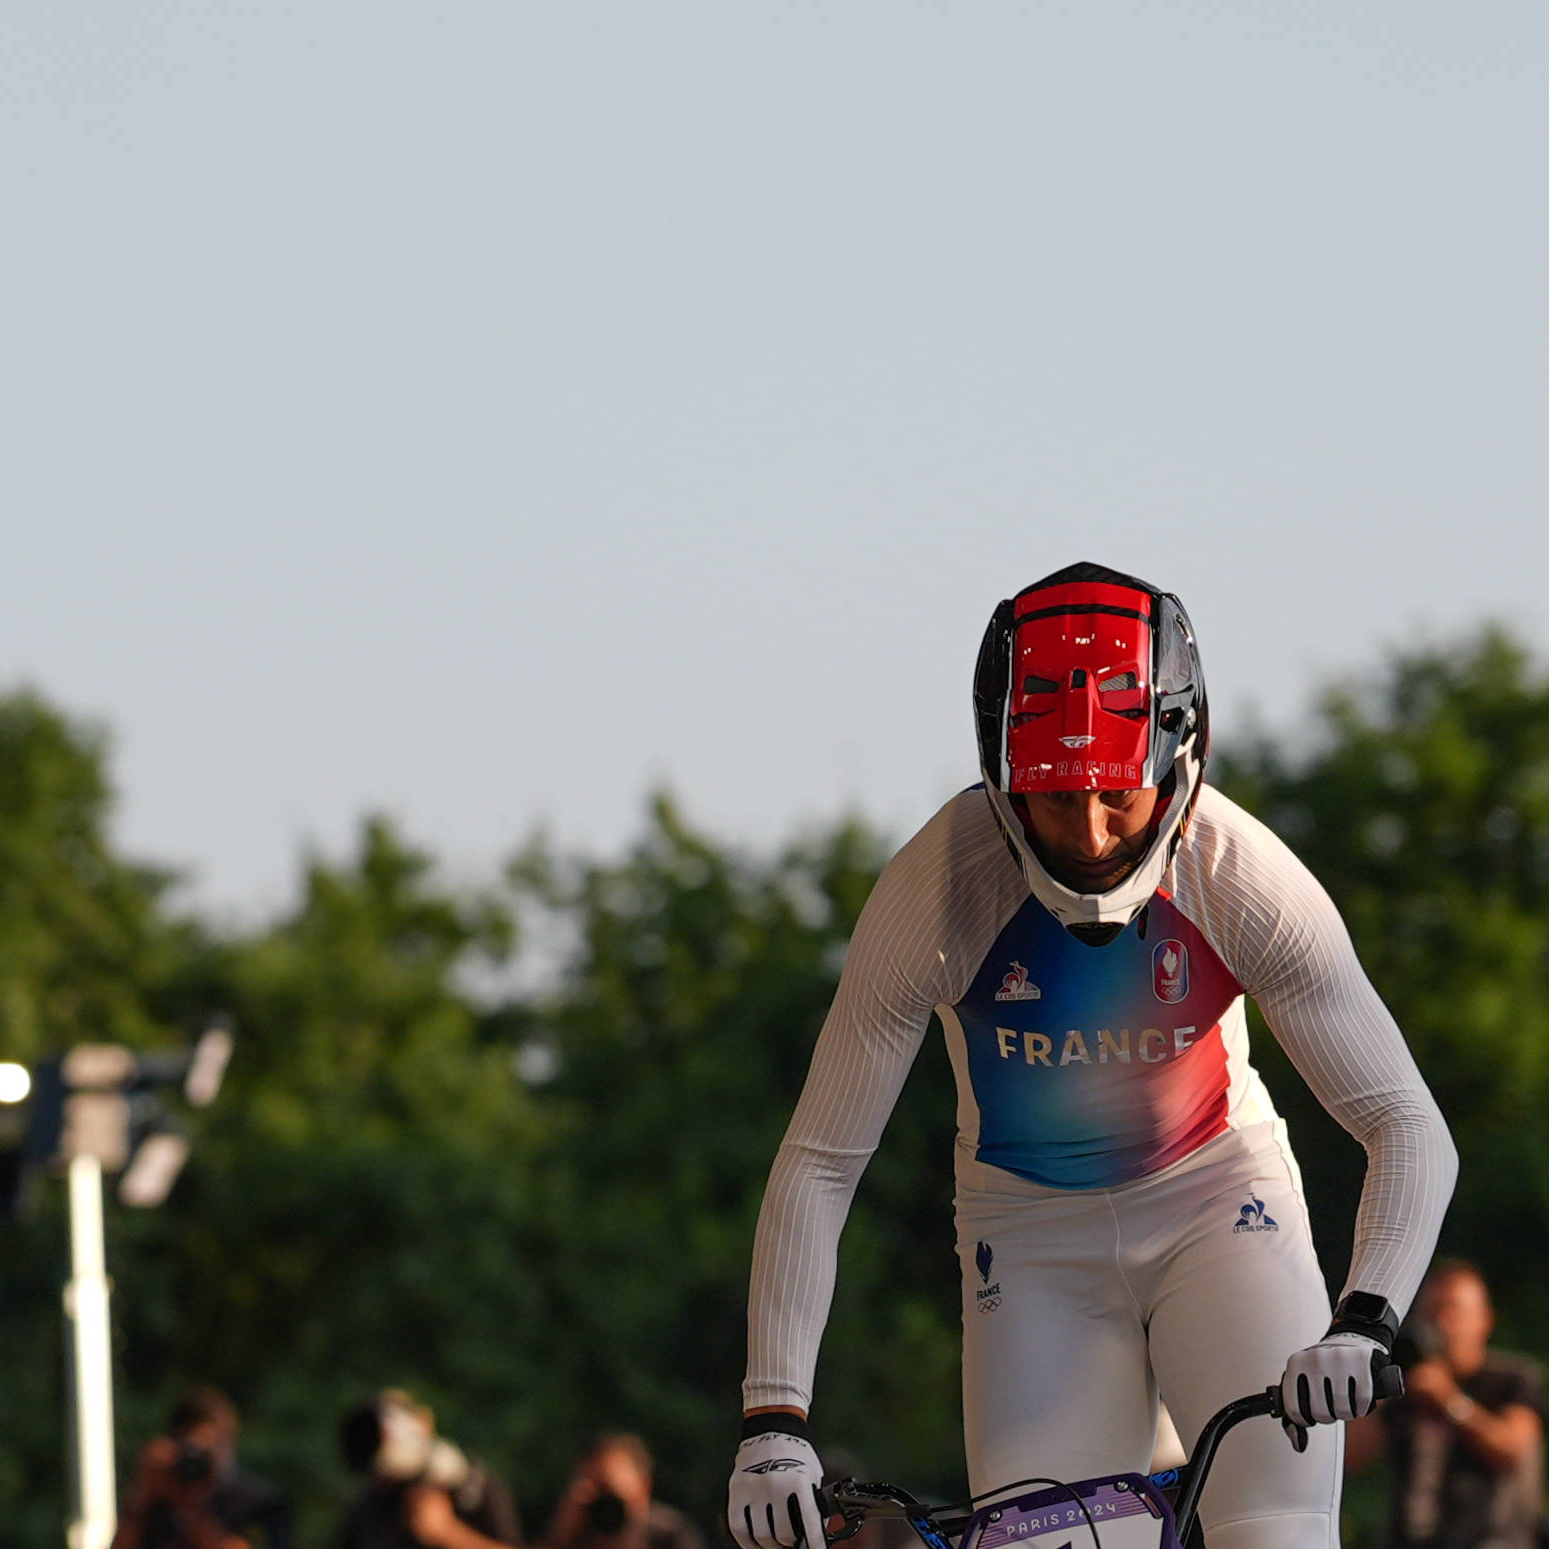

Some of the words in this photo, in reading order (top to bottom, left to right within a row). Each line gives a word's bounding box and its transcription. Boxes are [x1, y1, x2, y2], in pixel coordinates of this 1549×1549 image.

[1014, 763, 1050, 783] FLY
[1056, 760, 1137, 780] RACING
[995, 1025, 1196, 1068] FRANCE
[1007, 1513, 1060, 1537] PARIS
